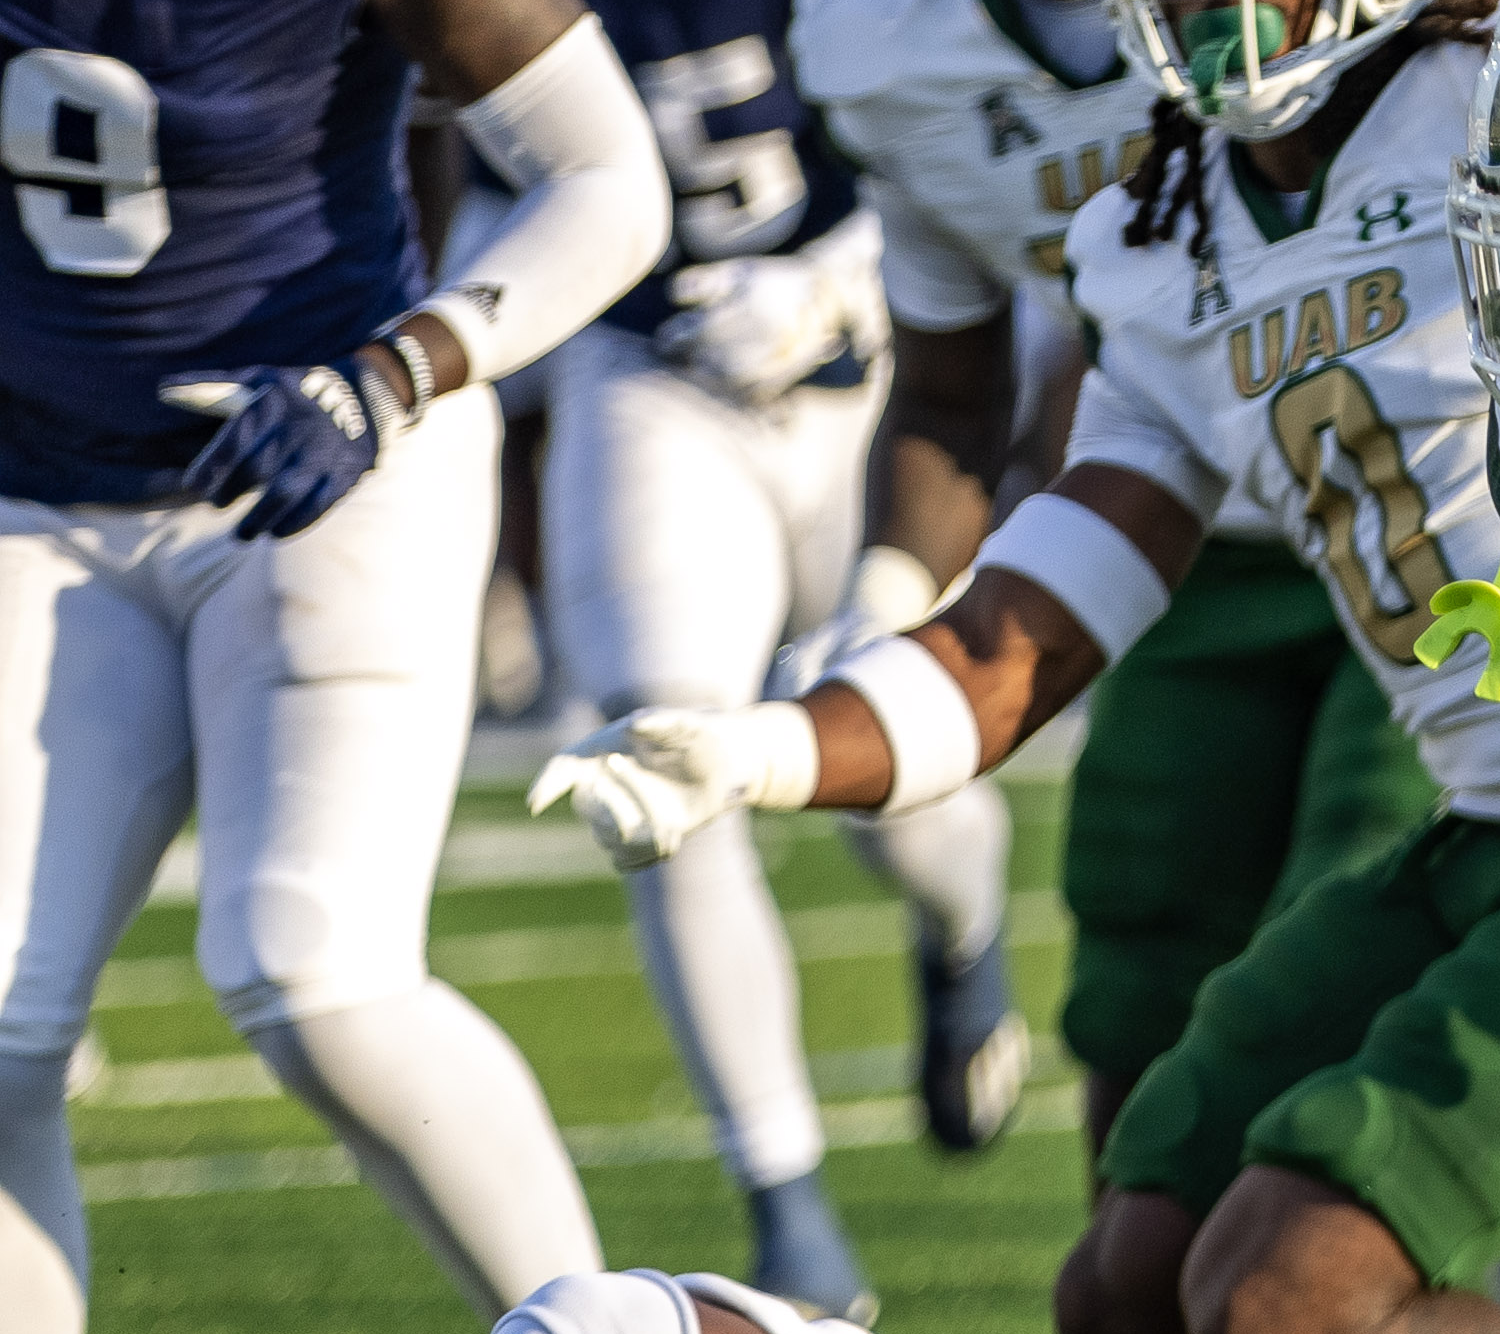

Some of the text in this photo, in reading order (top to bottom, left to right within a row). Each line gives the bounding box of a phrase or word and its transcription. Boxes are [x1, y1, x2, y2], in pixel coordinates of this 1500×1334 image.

[0, 47, 172, 278] 9
[1228, 266, 1409, 400] UAB
[1271, 357, 1455, 665] 0
